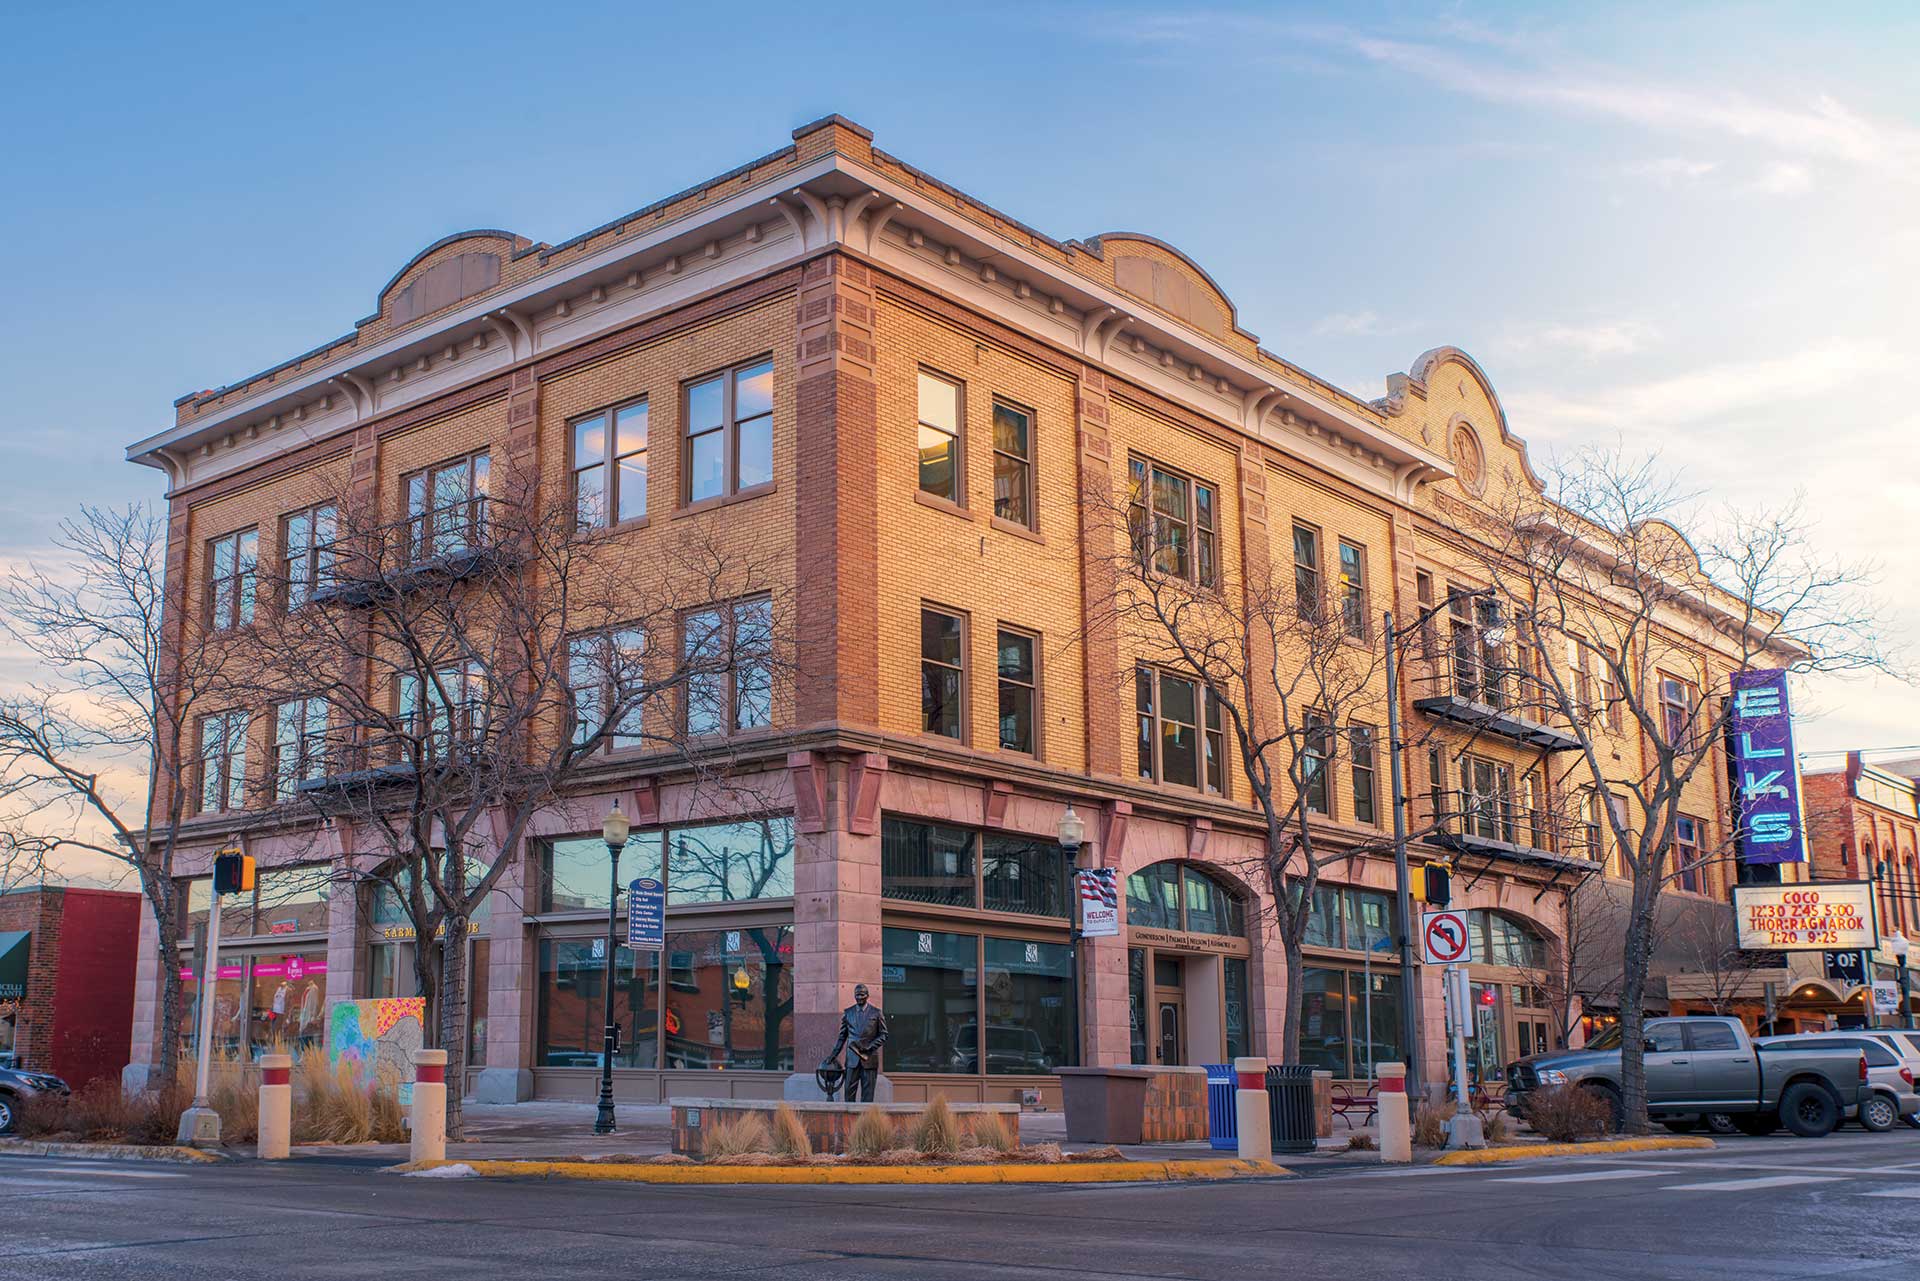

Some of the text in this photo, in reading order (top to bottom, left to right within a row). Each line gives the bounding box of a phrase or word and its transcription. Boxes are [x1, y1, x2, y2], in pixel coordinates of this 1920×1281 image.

[1734, 687, 1792, 843] ELKS
[1783, 892, 1819, 904] COCO
[1087, 910, 1113, 919] WELCOME
[1751, 904, 1854, 917] 12:30 2:45 5:00
[1770, 931, 1838, 944] 7:20 9:25
[1837, 953, 1858, 967] OF
